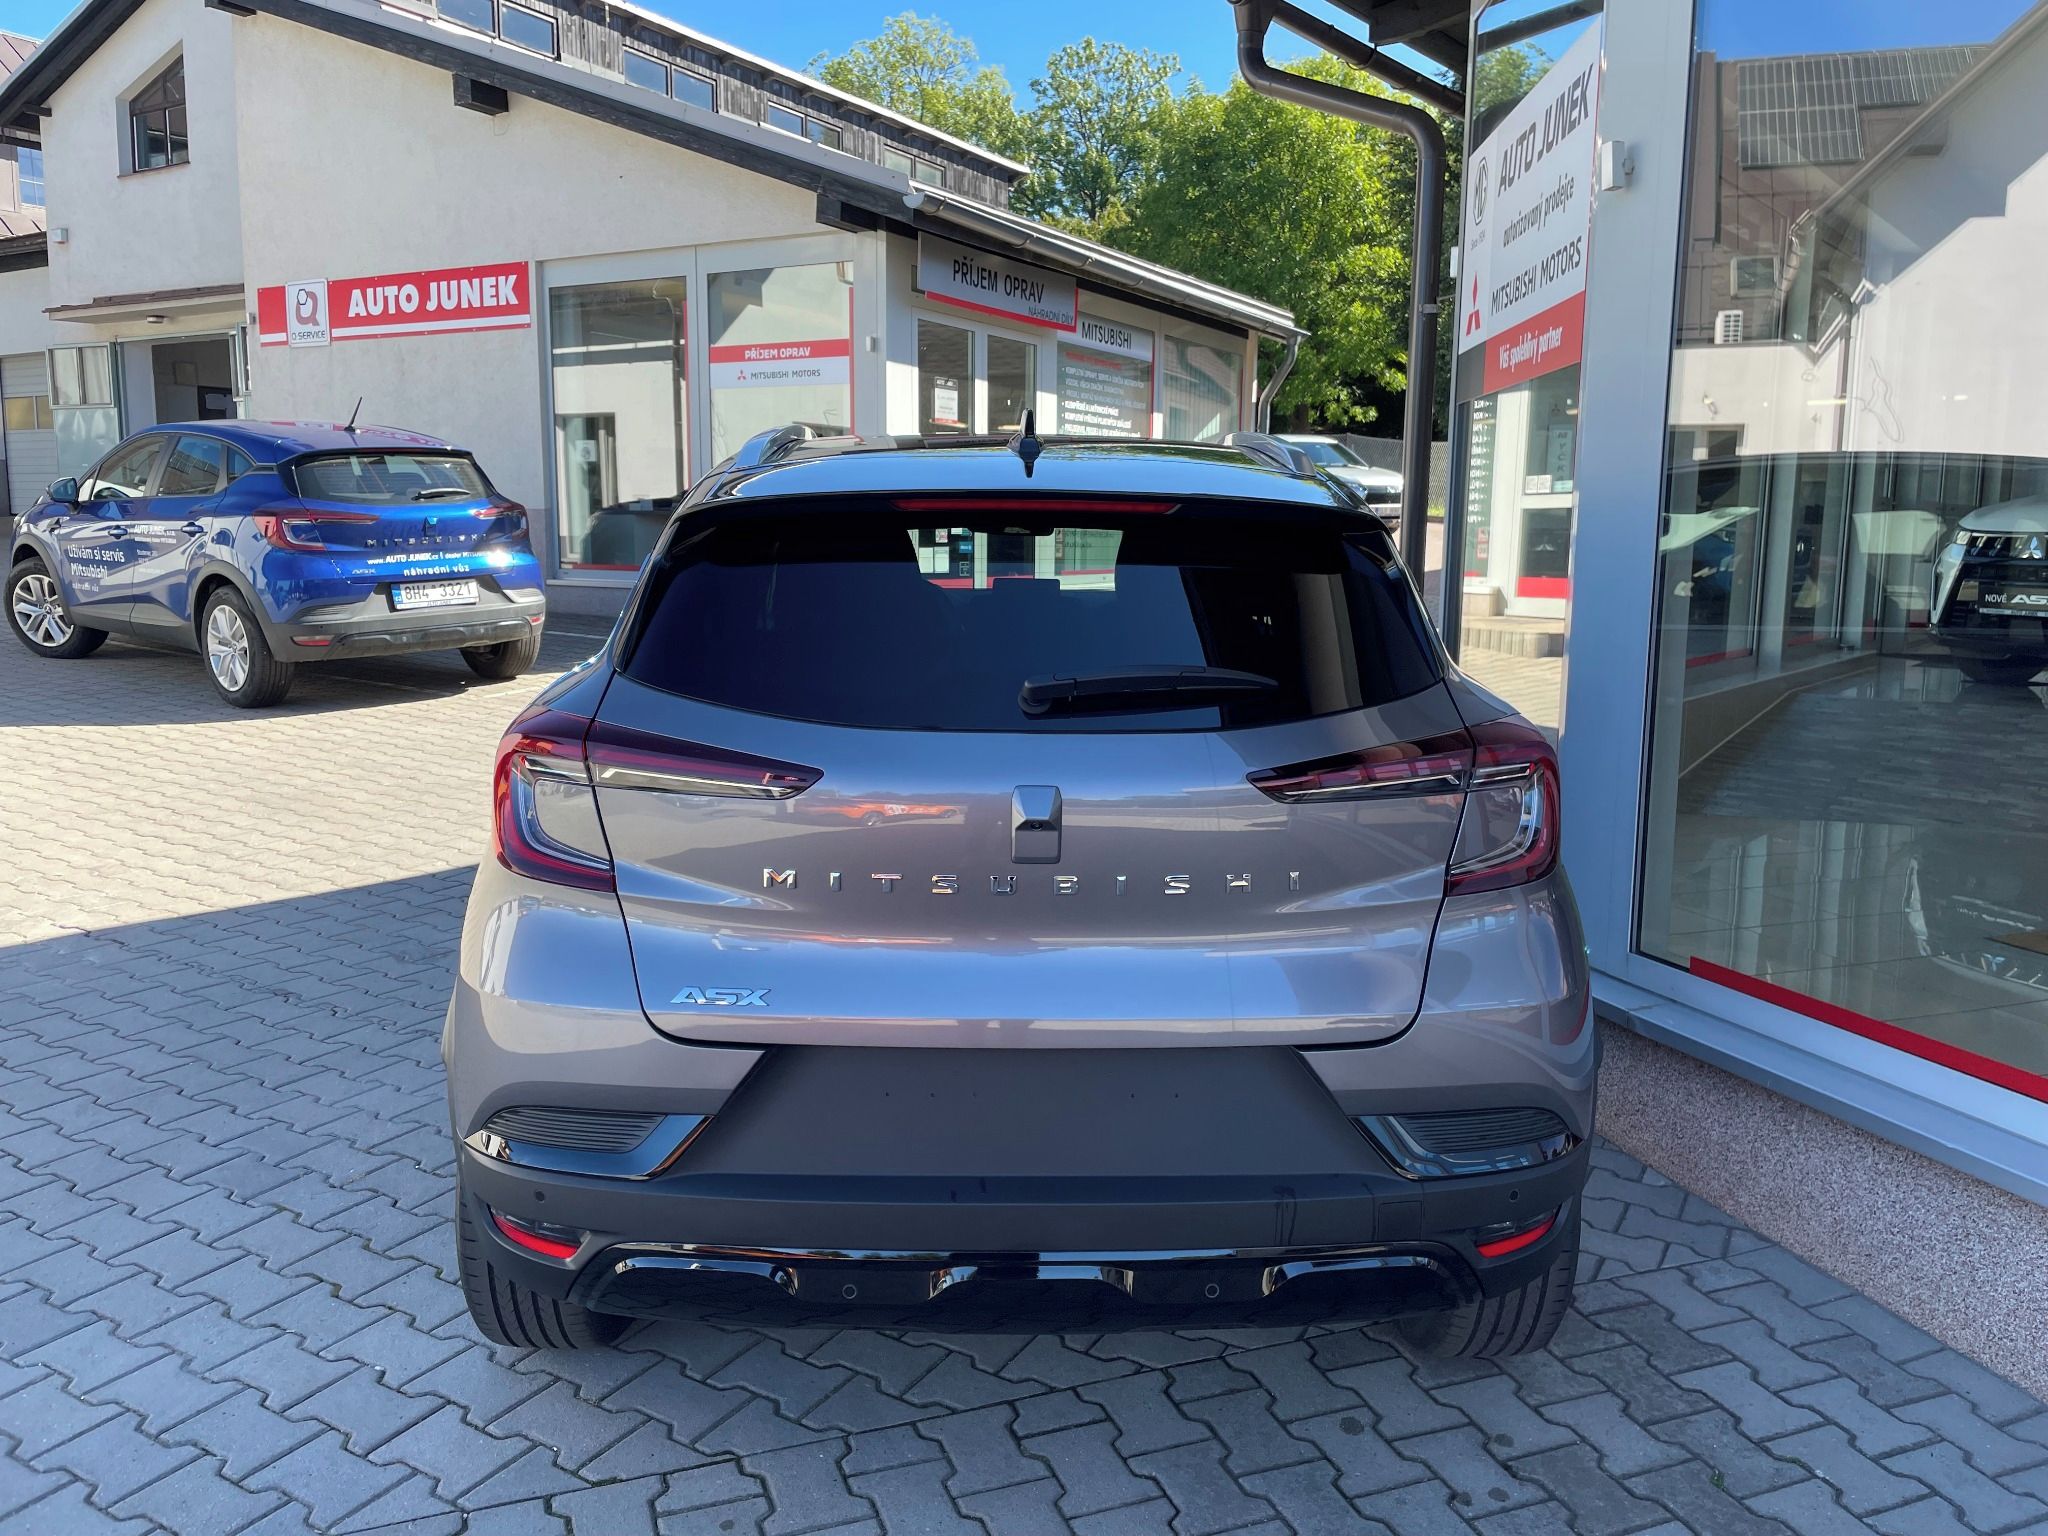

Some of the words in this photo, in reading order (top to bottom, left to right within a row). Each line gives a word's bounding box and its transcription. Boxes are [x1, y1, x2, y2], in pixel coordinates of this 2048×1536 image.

[1498, 121, 1536, 198] AUTO
[1537, 62, 1593, 163] JUNEK
[1544, 172, 1574, 228] prodejce
[952, 255, 998, 293] PŘÍJEM
[1004, 274, 1045, 304] OPRAV
[1491, 264, 1537, 316] MITSUBISHI
[1540, 235, 1582, 288] MOTORS
[348, 284, 419, 317] AUTO
[425, 274, 518, 312] JUNEK
[1028, 306, 1060, 322] NÁHRADNÍ
[1081, 322, 1132, 350] MITSUBISHI
[1538, 326, 1563, 363] partner
[744, 347, 778, 360] PŘÍJEM
[780, 346, 811, 358] OPRAV
[751, 371, 789, 380] MITSUBISHI
[792, 369, 821, 378] MOTORS
[68, 544, 94, 560] Užívám
[95, 547, 101, 560] si
[101, 548, 125, 562] servis
[71, 562, 108, 580] Mitsubishi
[404, 565, 450, 576] náhradní
[453, 563, 470, 573] vůz
[404, 584, 430, 600] 8H4
[440, 581, 473, 598] 3321
[1985, 592, 2008, 603] NOVÉ
[2011, 594, 2048, 605] AS
[762, 866, 1300, 896] MITSUBISHI
[670, 985, 772, 1006] ASX
